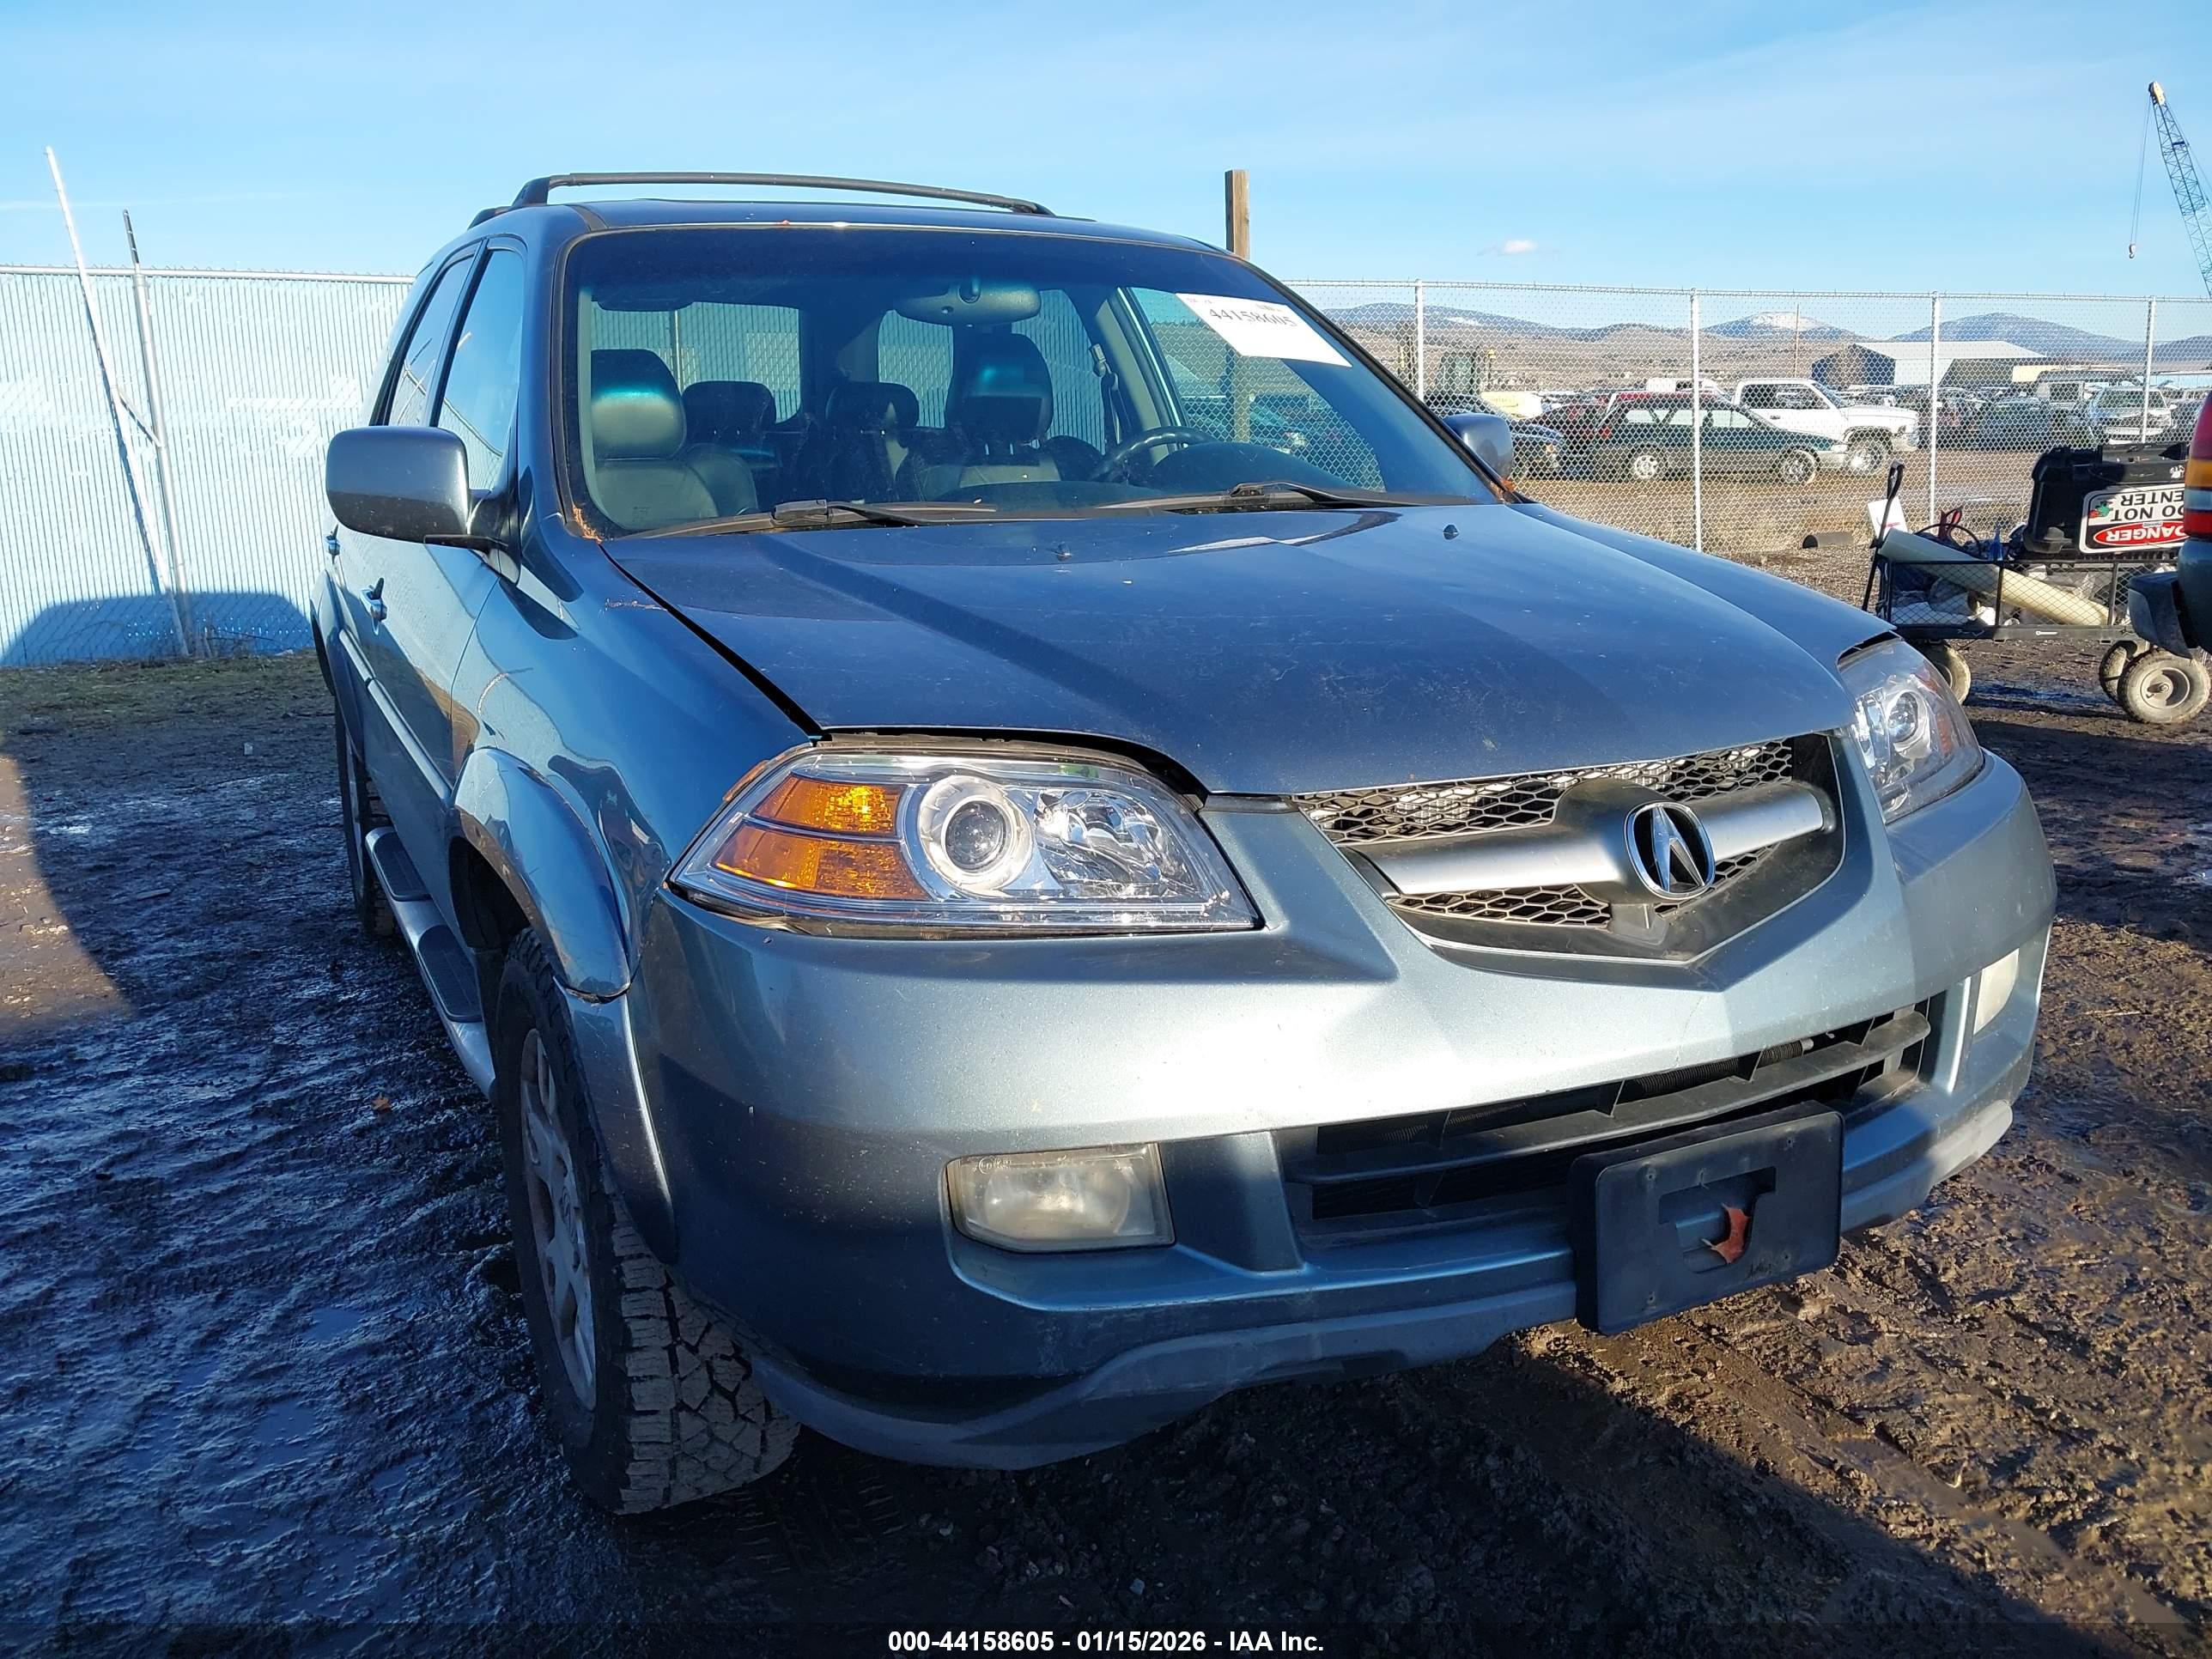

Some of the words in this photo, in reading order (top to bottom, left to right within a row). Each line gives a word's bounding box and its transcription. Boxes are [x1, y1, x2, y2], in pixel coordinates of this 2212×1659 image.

[1210, 308, 1297, 327] 44158605
[2121, 490, 2185, 506] ENTER
[2111, 507, 2154, 522] NOT
